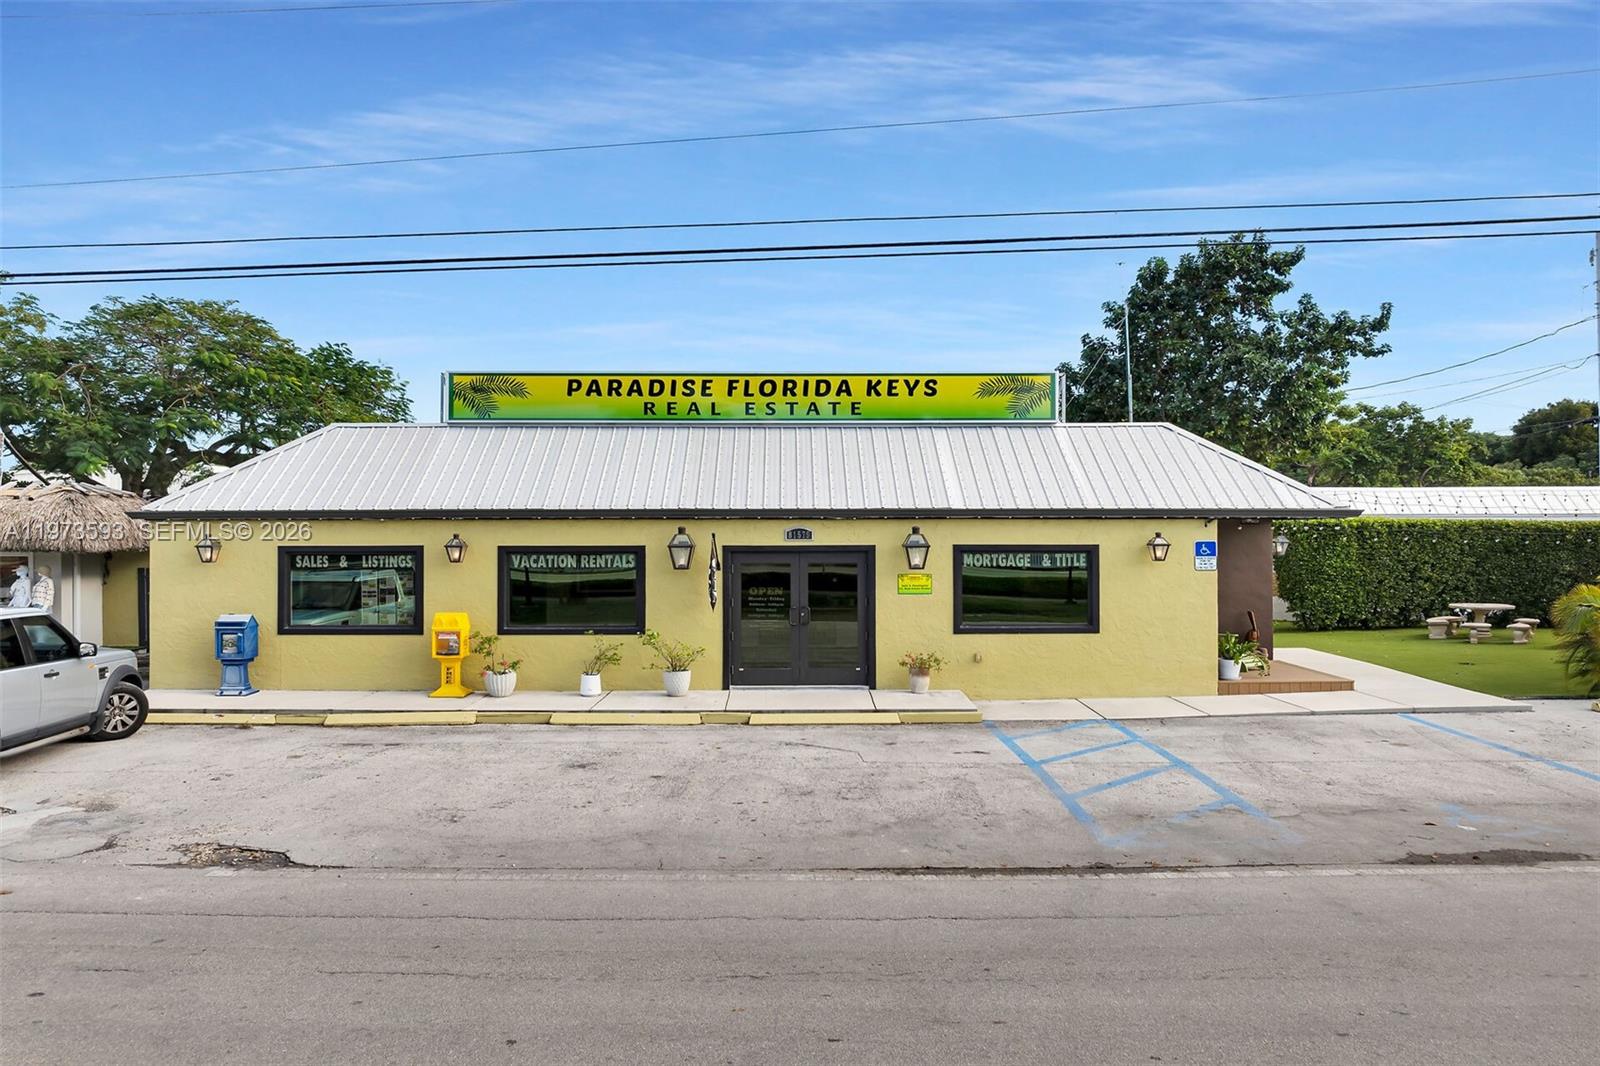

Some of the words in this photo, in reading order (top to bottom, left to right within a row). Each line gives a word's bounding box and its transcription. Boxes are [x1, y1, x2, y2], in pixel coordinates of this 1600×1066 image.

[566, 379, 713, 397] PARADISE
[727, 379, 852, 397] FLORIDA
[866, 379, 938, 397] KEYS
[643, 401, 721, 416] REAL
[744, 401, 862, 416] ESTATE
[295, 555, 329, 568] SALES
[339, 555, 348, 568] &
[362, 555, 413, 568] LISTINGS
[511, 554, 576, 568] VACATION
[580, 554, 635, 568] RENTALS
[963, 553, 1031, 567] MORTGAGE
[1042, 553, 1051, 567] &
[1055, 553, 1086, 567] TITLE
[749, 586, 784, 596] OPEN
